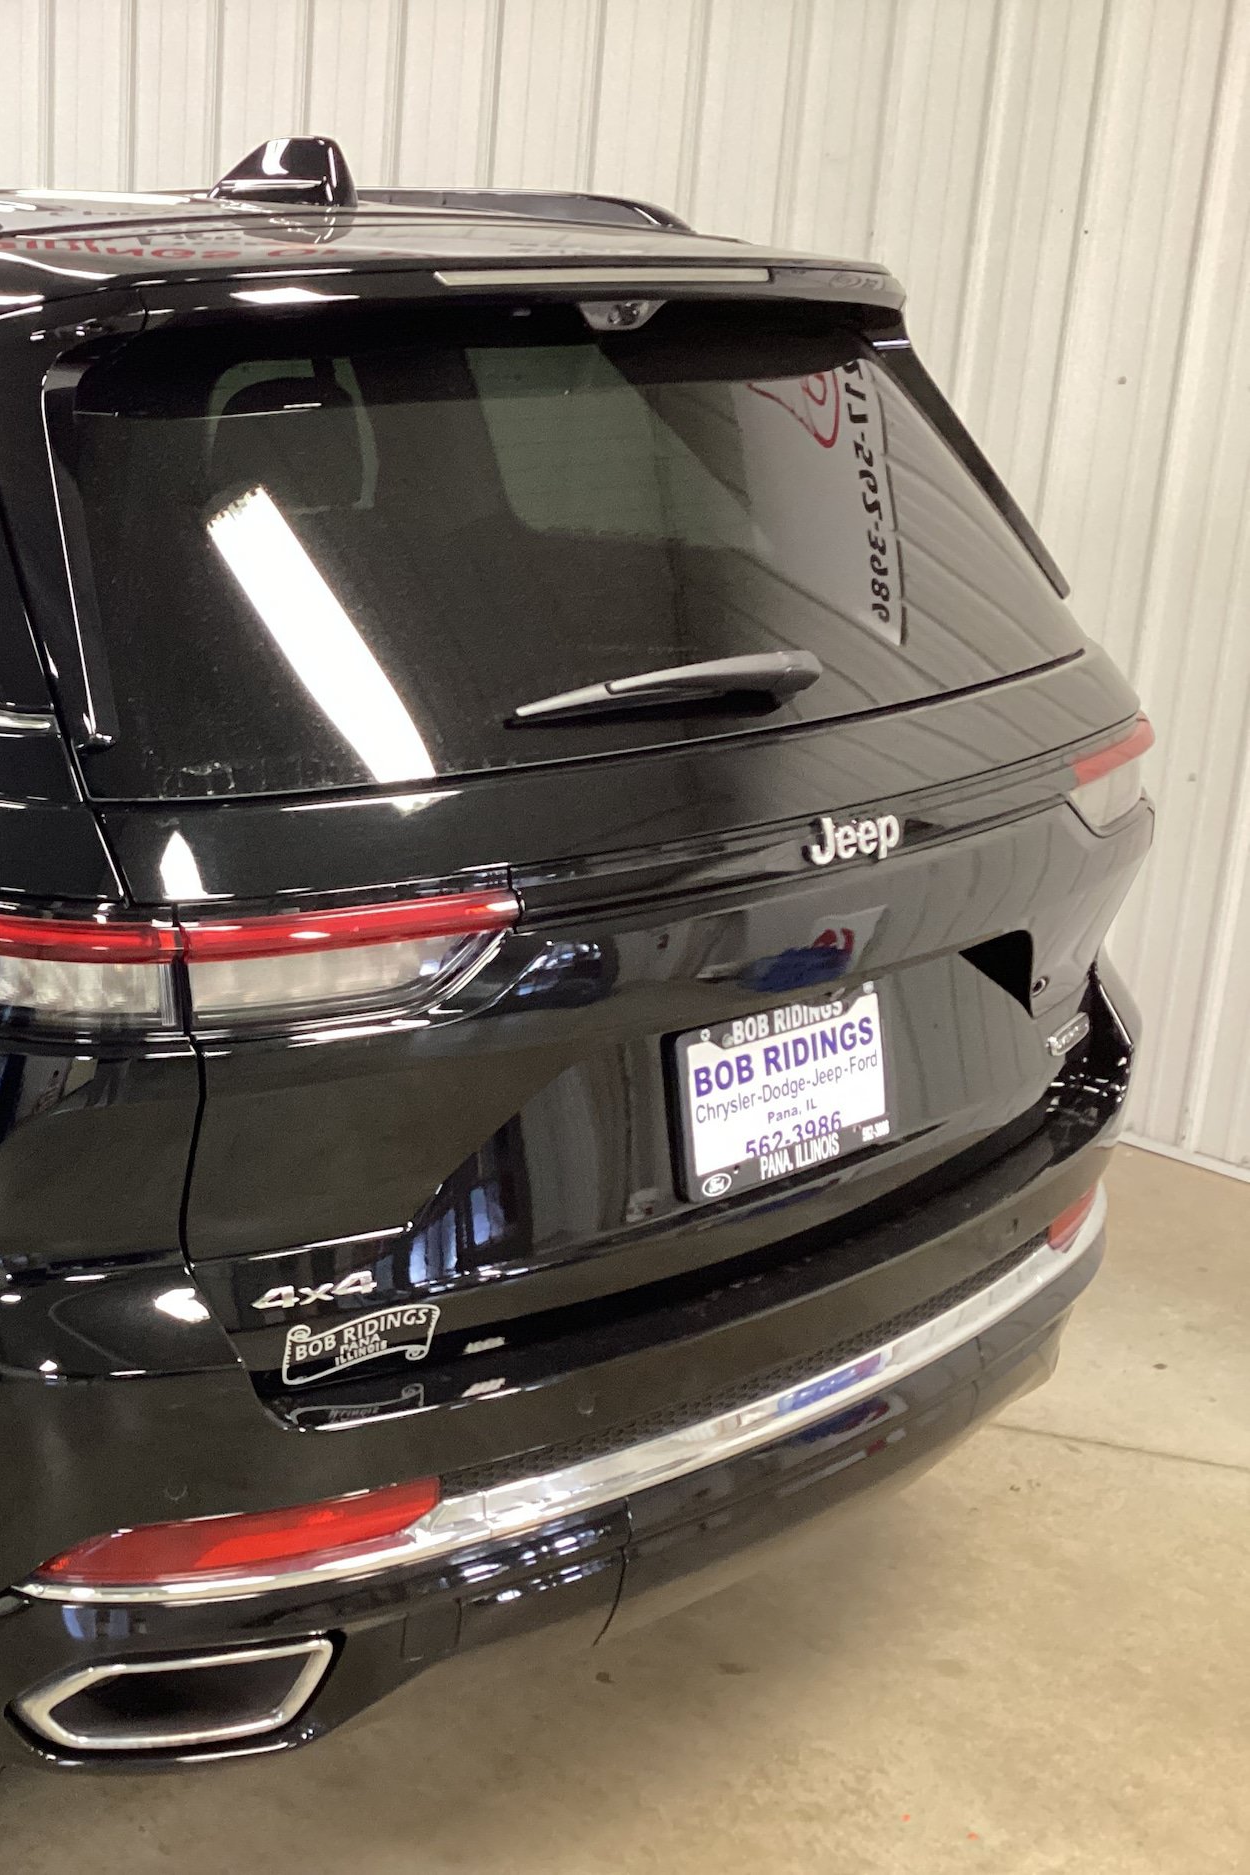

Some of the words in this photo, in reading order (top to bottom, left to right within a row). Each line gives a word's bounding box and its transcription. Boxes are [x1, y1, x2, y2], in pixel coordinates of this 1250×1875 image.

[810, 814, 900, 866] Jeep
[732, 1013, 770, 1046] BOB
[773, 1000, 843, 1034] RIDINGS
[693, 1053, 754, 1098] BOB
[763, 1016, 874, 1077] RIDINGS
[806, 1097, 818, 1112] IL
[745, 1110, 842, 1158] 562-3986
[794, 1131, 840, 1169] ILLINOIS
[251, 1269, 378, 1310] 4x4
[295, 1333, 337, 1361] BOB
[343, 1308, 430, 1343] RIDINGS
[334, 1339, 388, 1367] ILLINOIS
[339, 1333, 381, 1355] PANA
